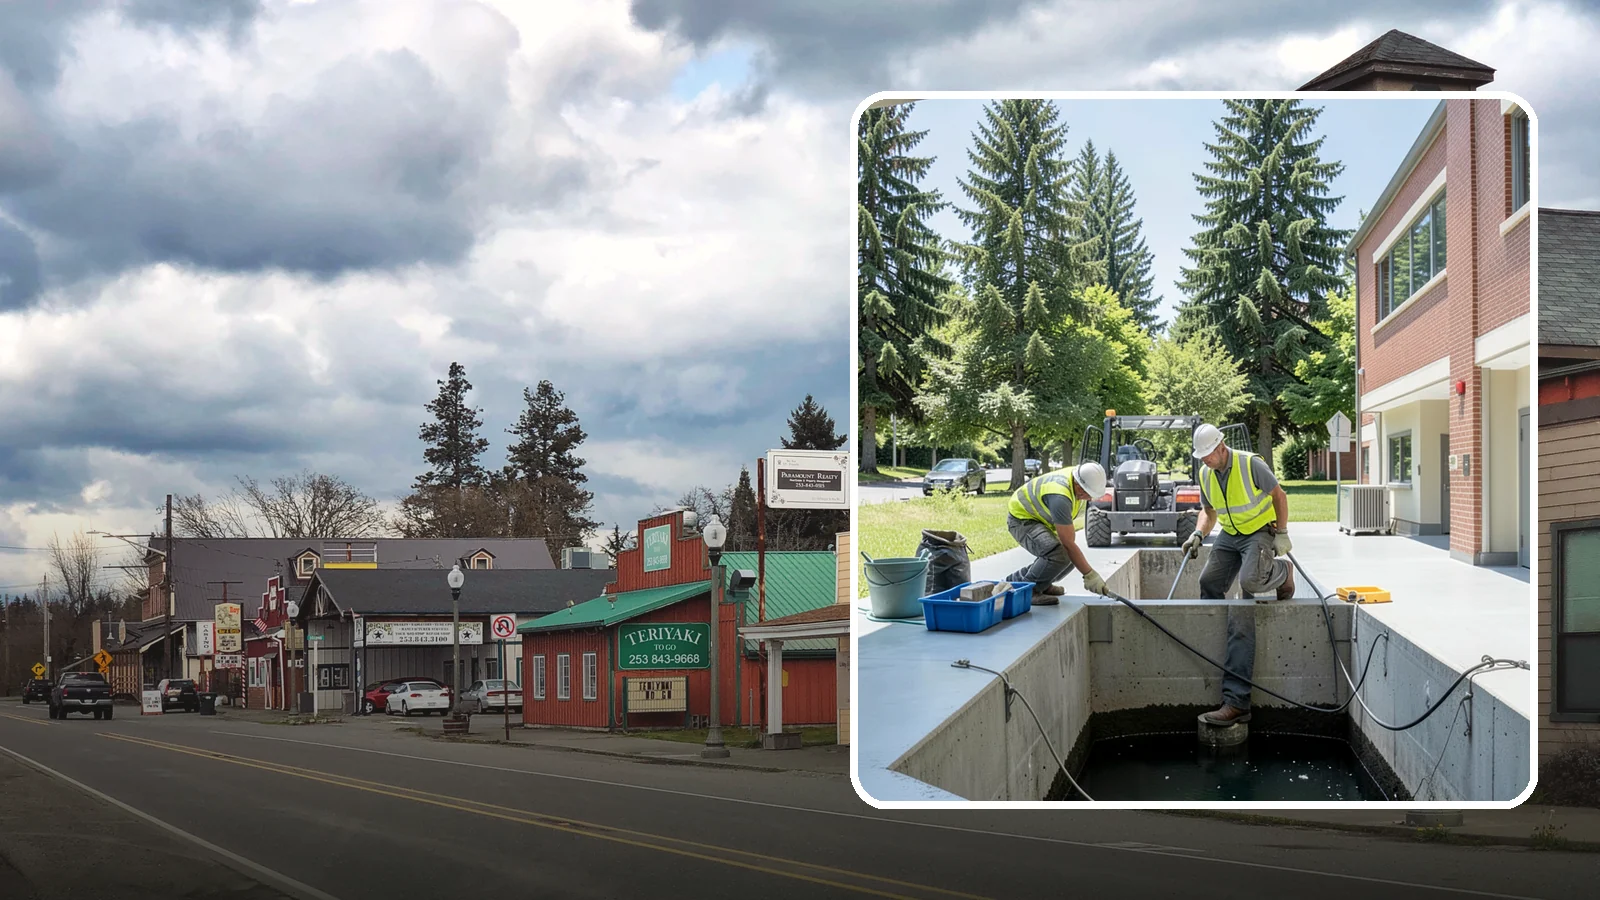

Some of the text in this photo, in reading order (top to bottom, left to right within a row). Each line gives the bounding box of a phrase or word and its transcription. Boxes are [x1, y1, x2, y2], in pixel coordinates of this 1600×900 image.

[625, 627, 702, 646] TERIYAKI
[628, 653, 700, 664] 253 843-9668
[639, 681, 673, 691] TERIYAKI
